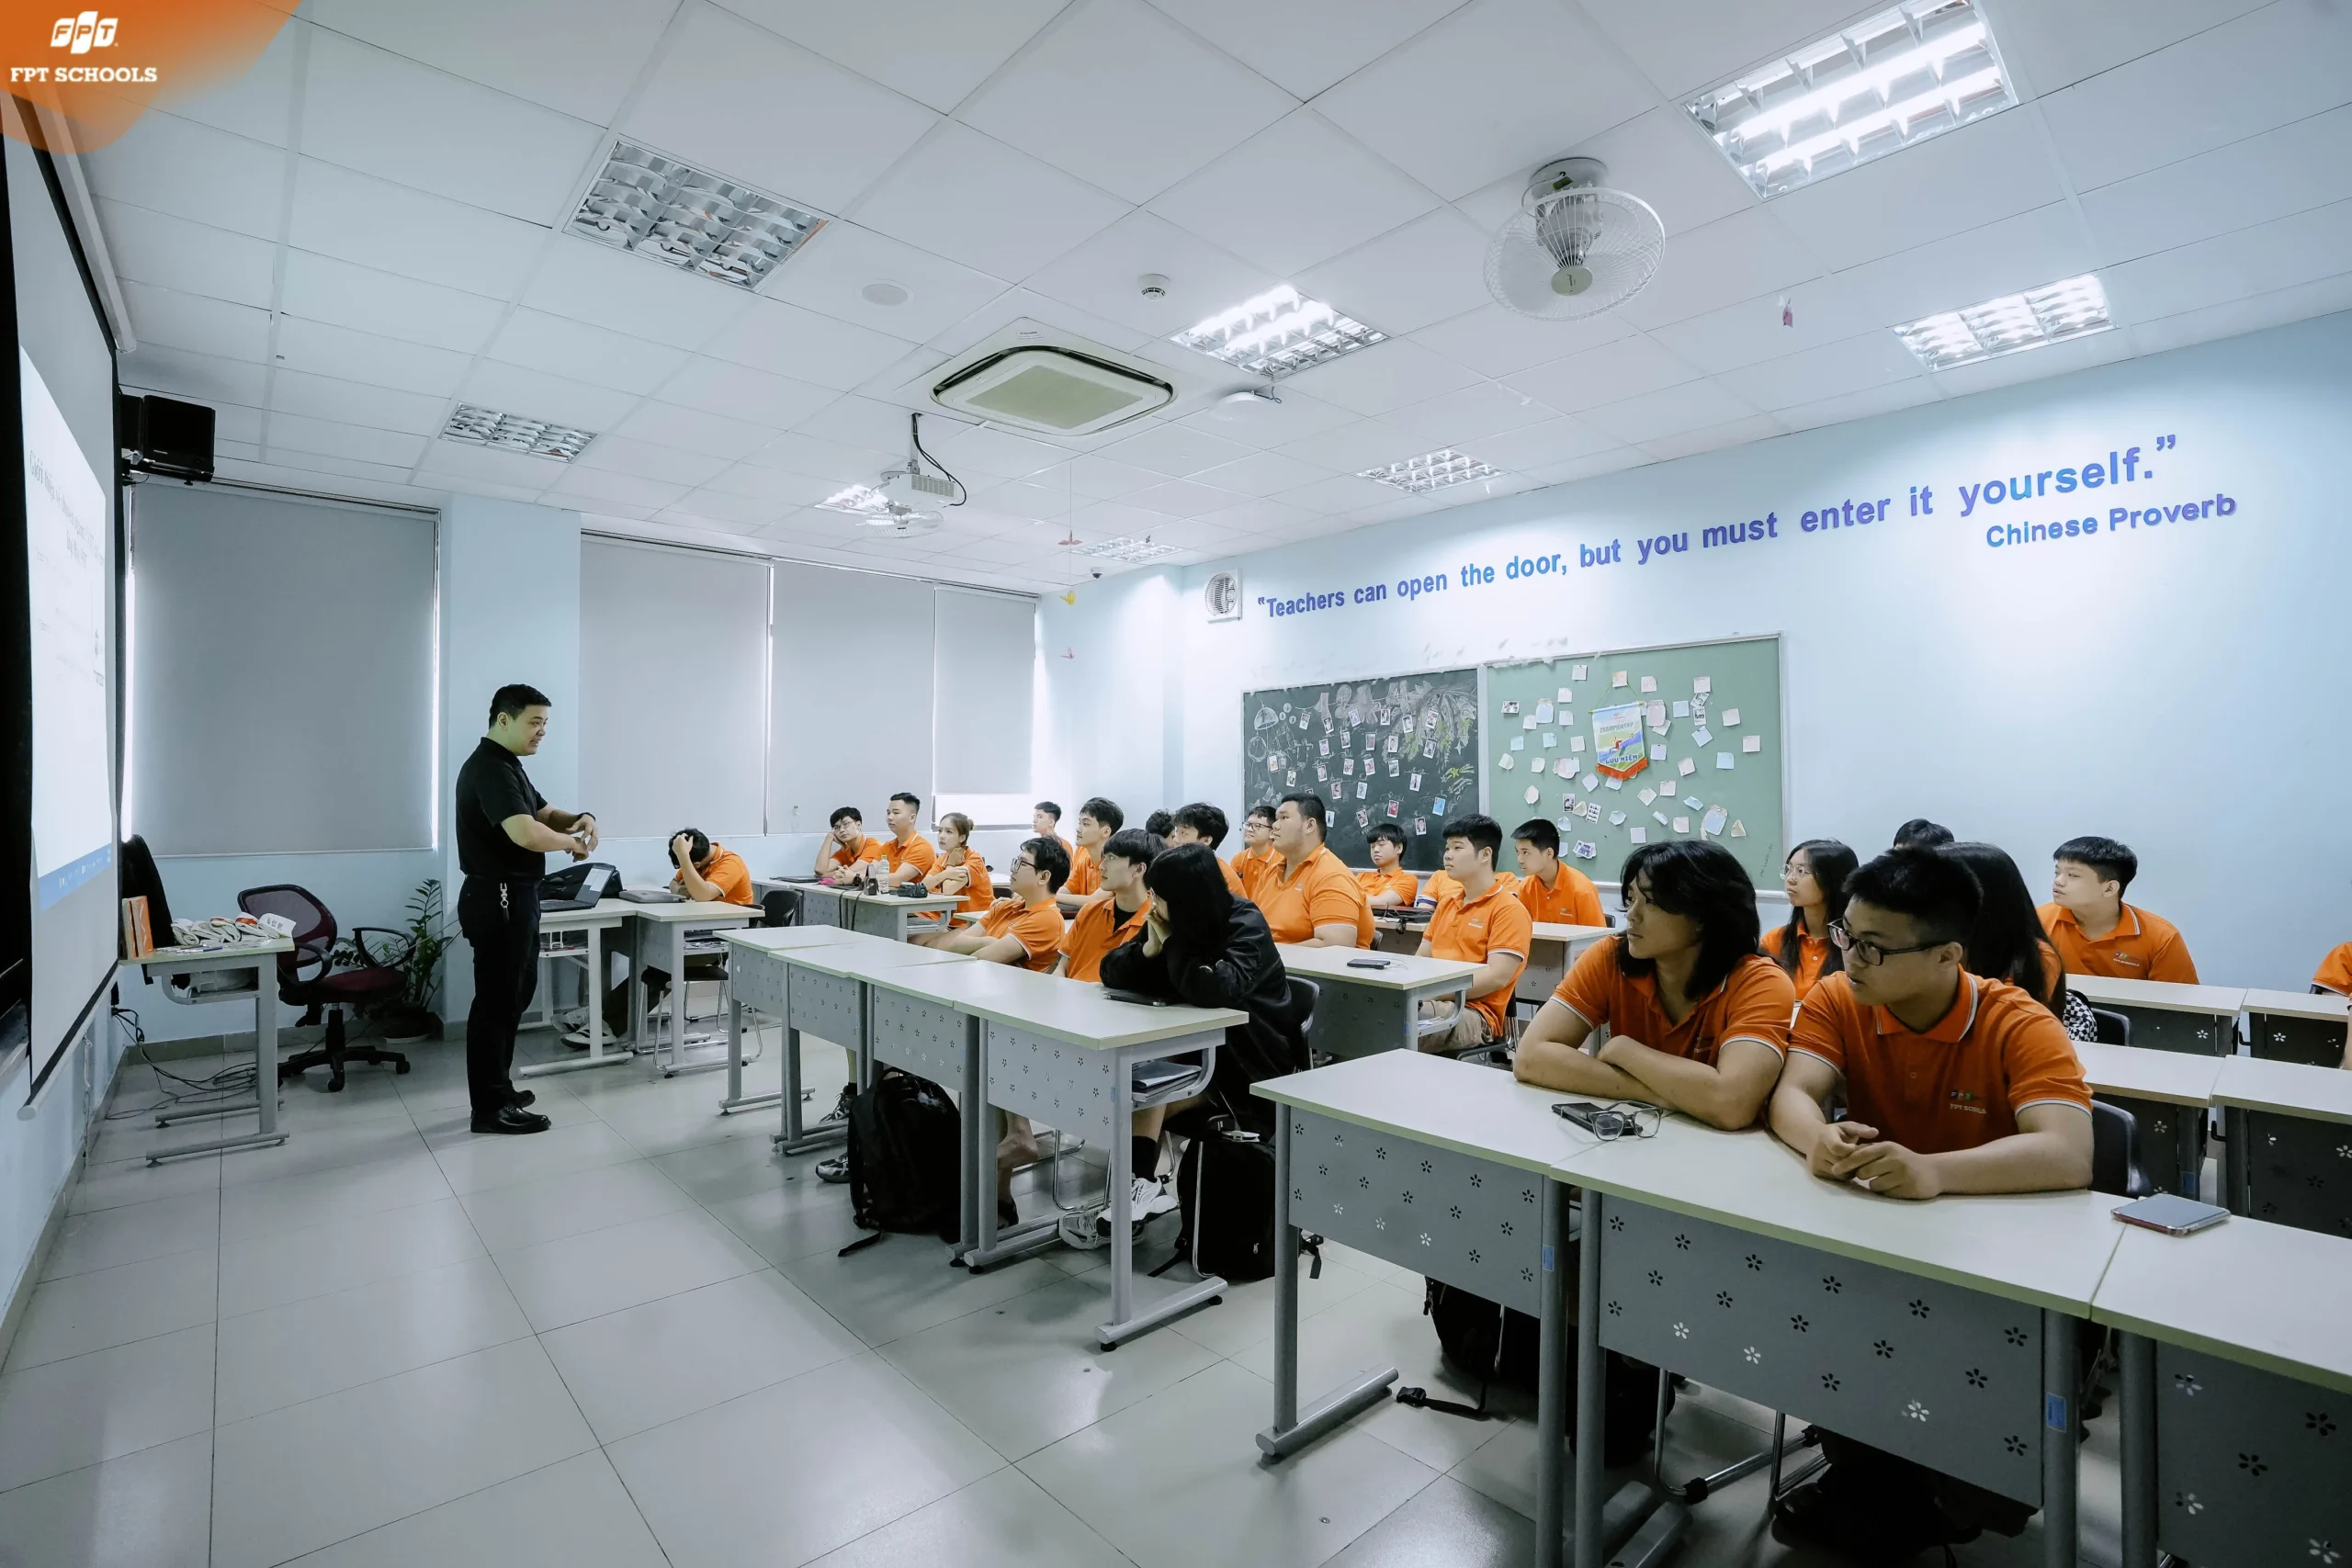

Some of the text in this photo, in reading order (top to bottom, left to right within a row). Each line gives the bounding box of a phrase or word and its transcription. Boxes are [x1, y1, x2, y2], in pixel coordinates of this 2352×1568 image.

[1352, 582, 1388, 606] can
[1396, 573, 1449, 602] open
[1461, 562, 1496, 588] the
[1505, 555, 1567, 581] door,
[1578, 537, 1623, 569] but
[1635, 530, 1690, 567] you
[1701, 511, 1781, 551] must
[1799, 492, 1893, 535] enter
[1908, 484, 1935, 518] it
[1985, 492, 2239, 548] Chinese Proverb
